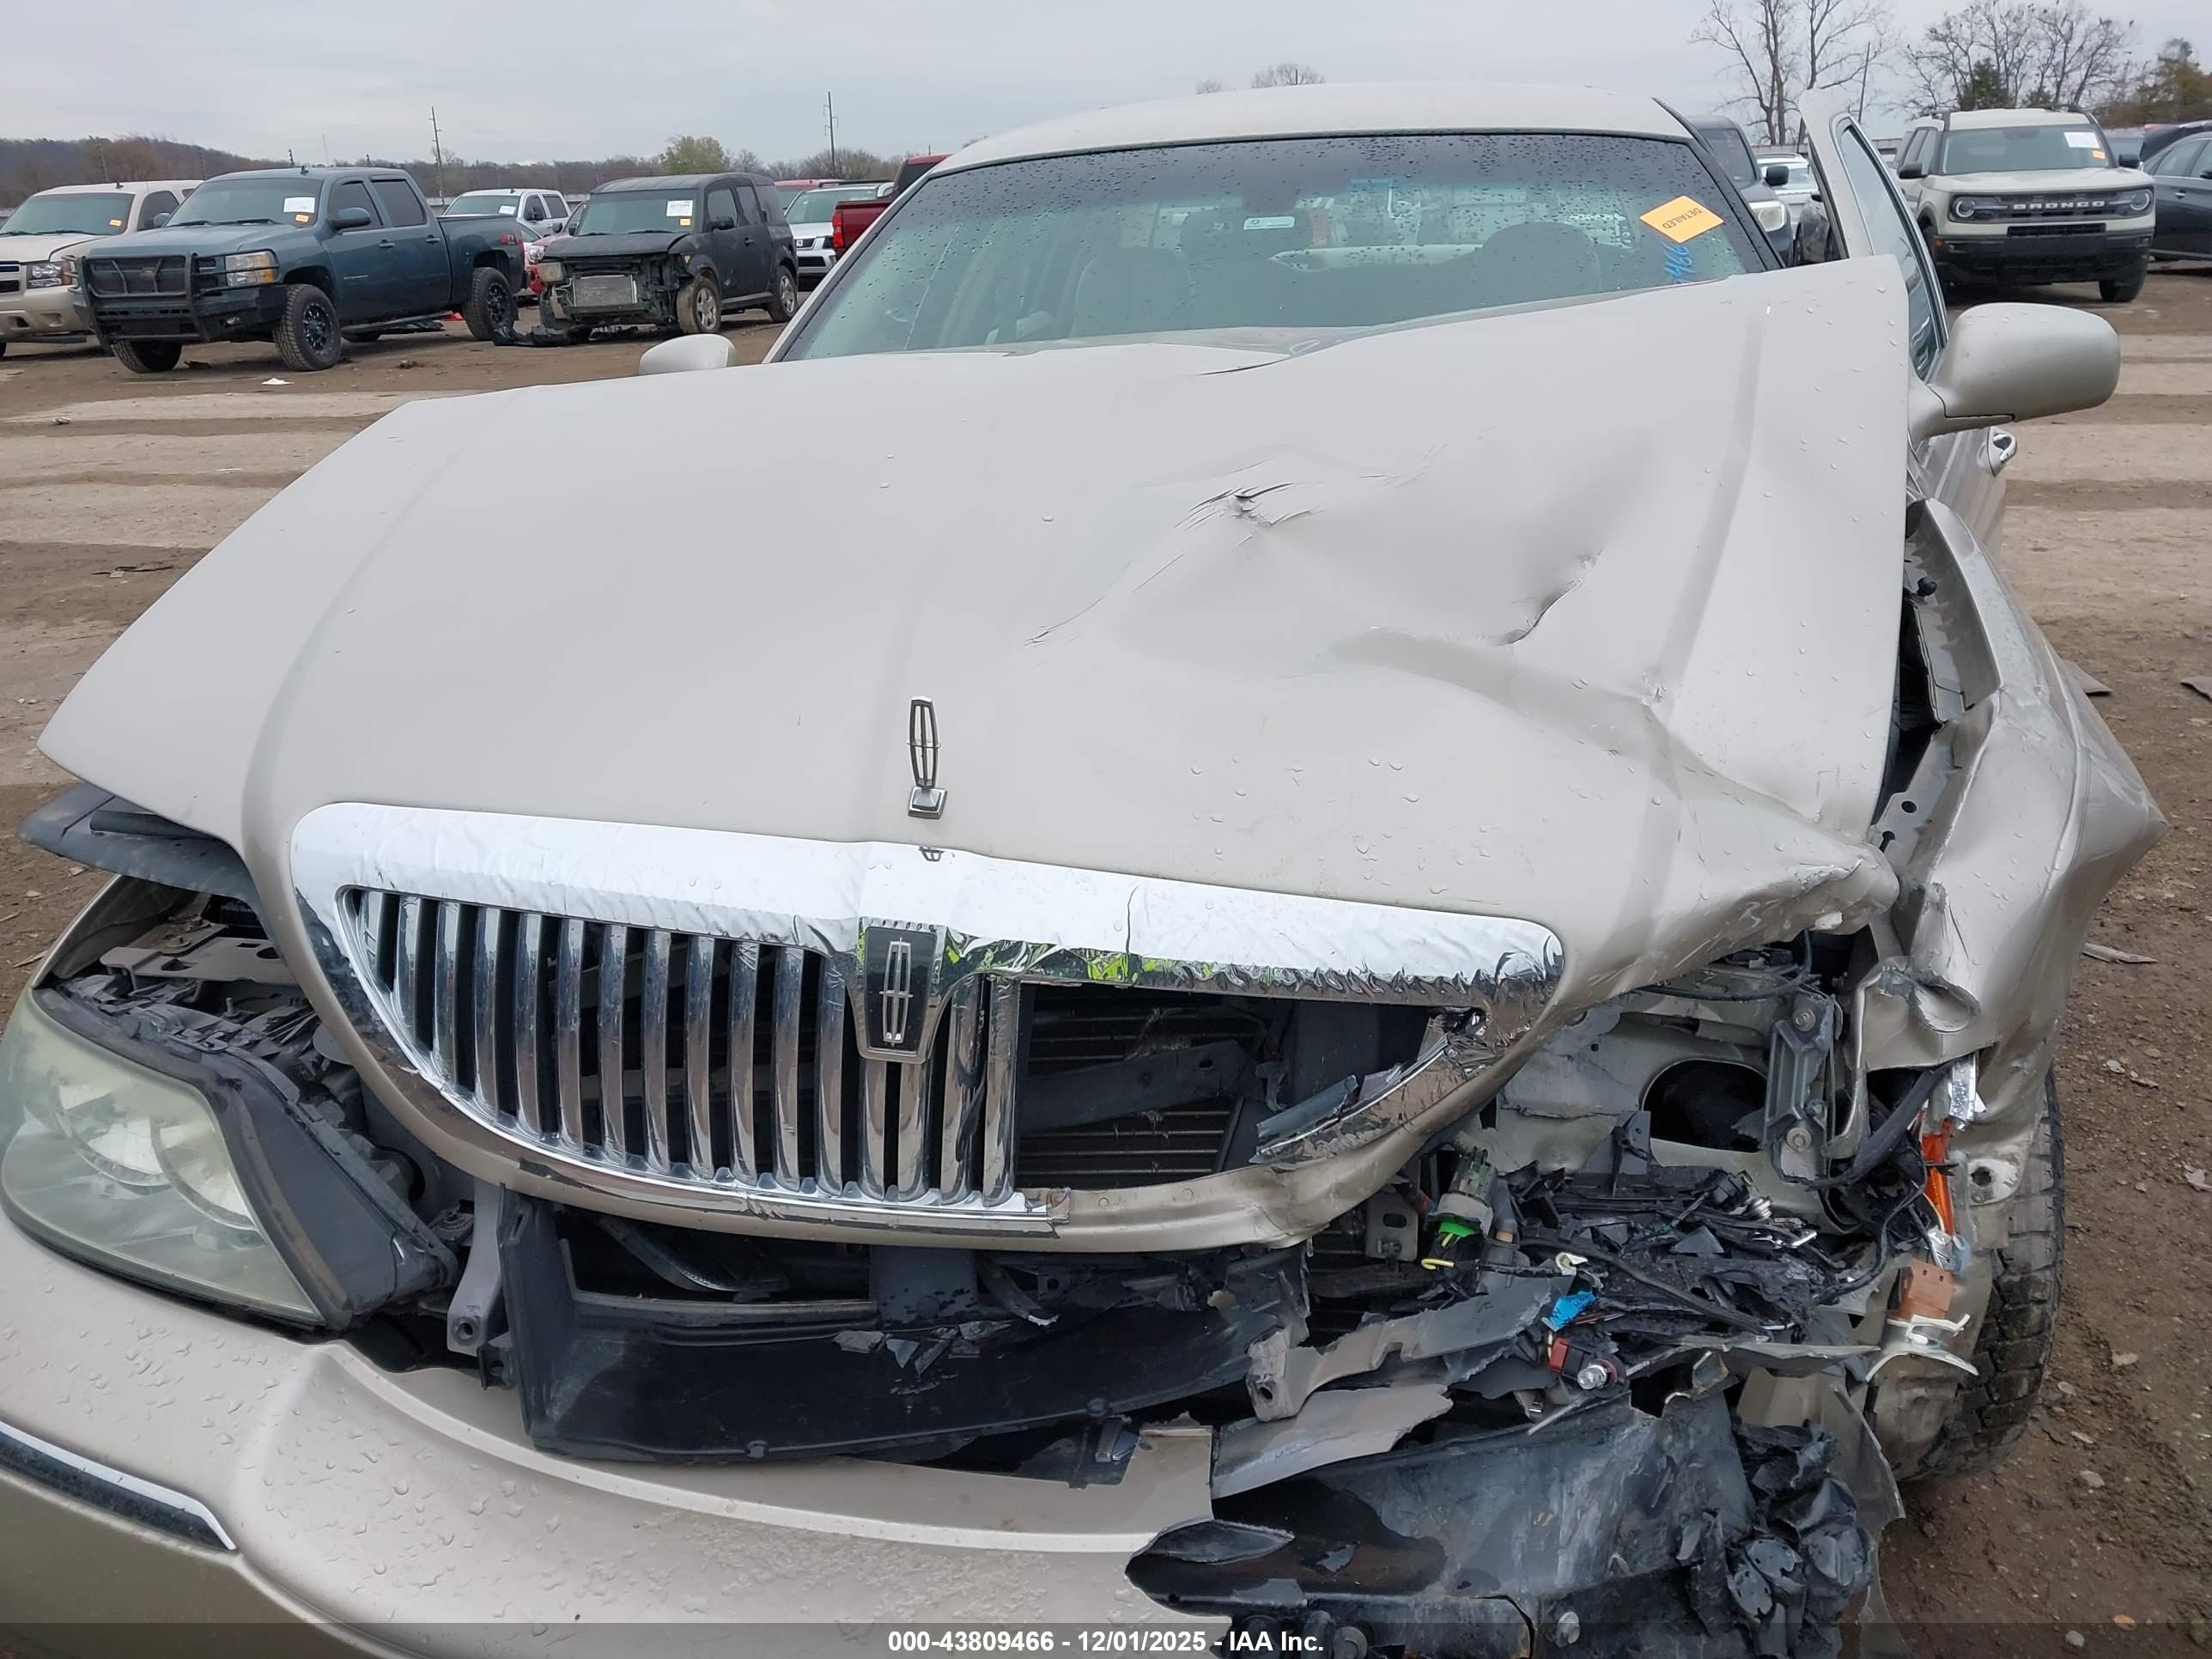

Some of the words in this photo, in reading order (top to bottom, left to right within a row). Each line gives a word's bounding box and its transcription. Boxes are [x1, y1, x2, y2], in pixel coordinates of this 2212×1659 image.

[2014, 201, 2105, 210] BRONCO
[1662, 208, 1702, 228] DETAILED
[1662, 240, 1697, 284] 466
